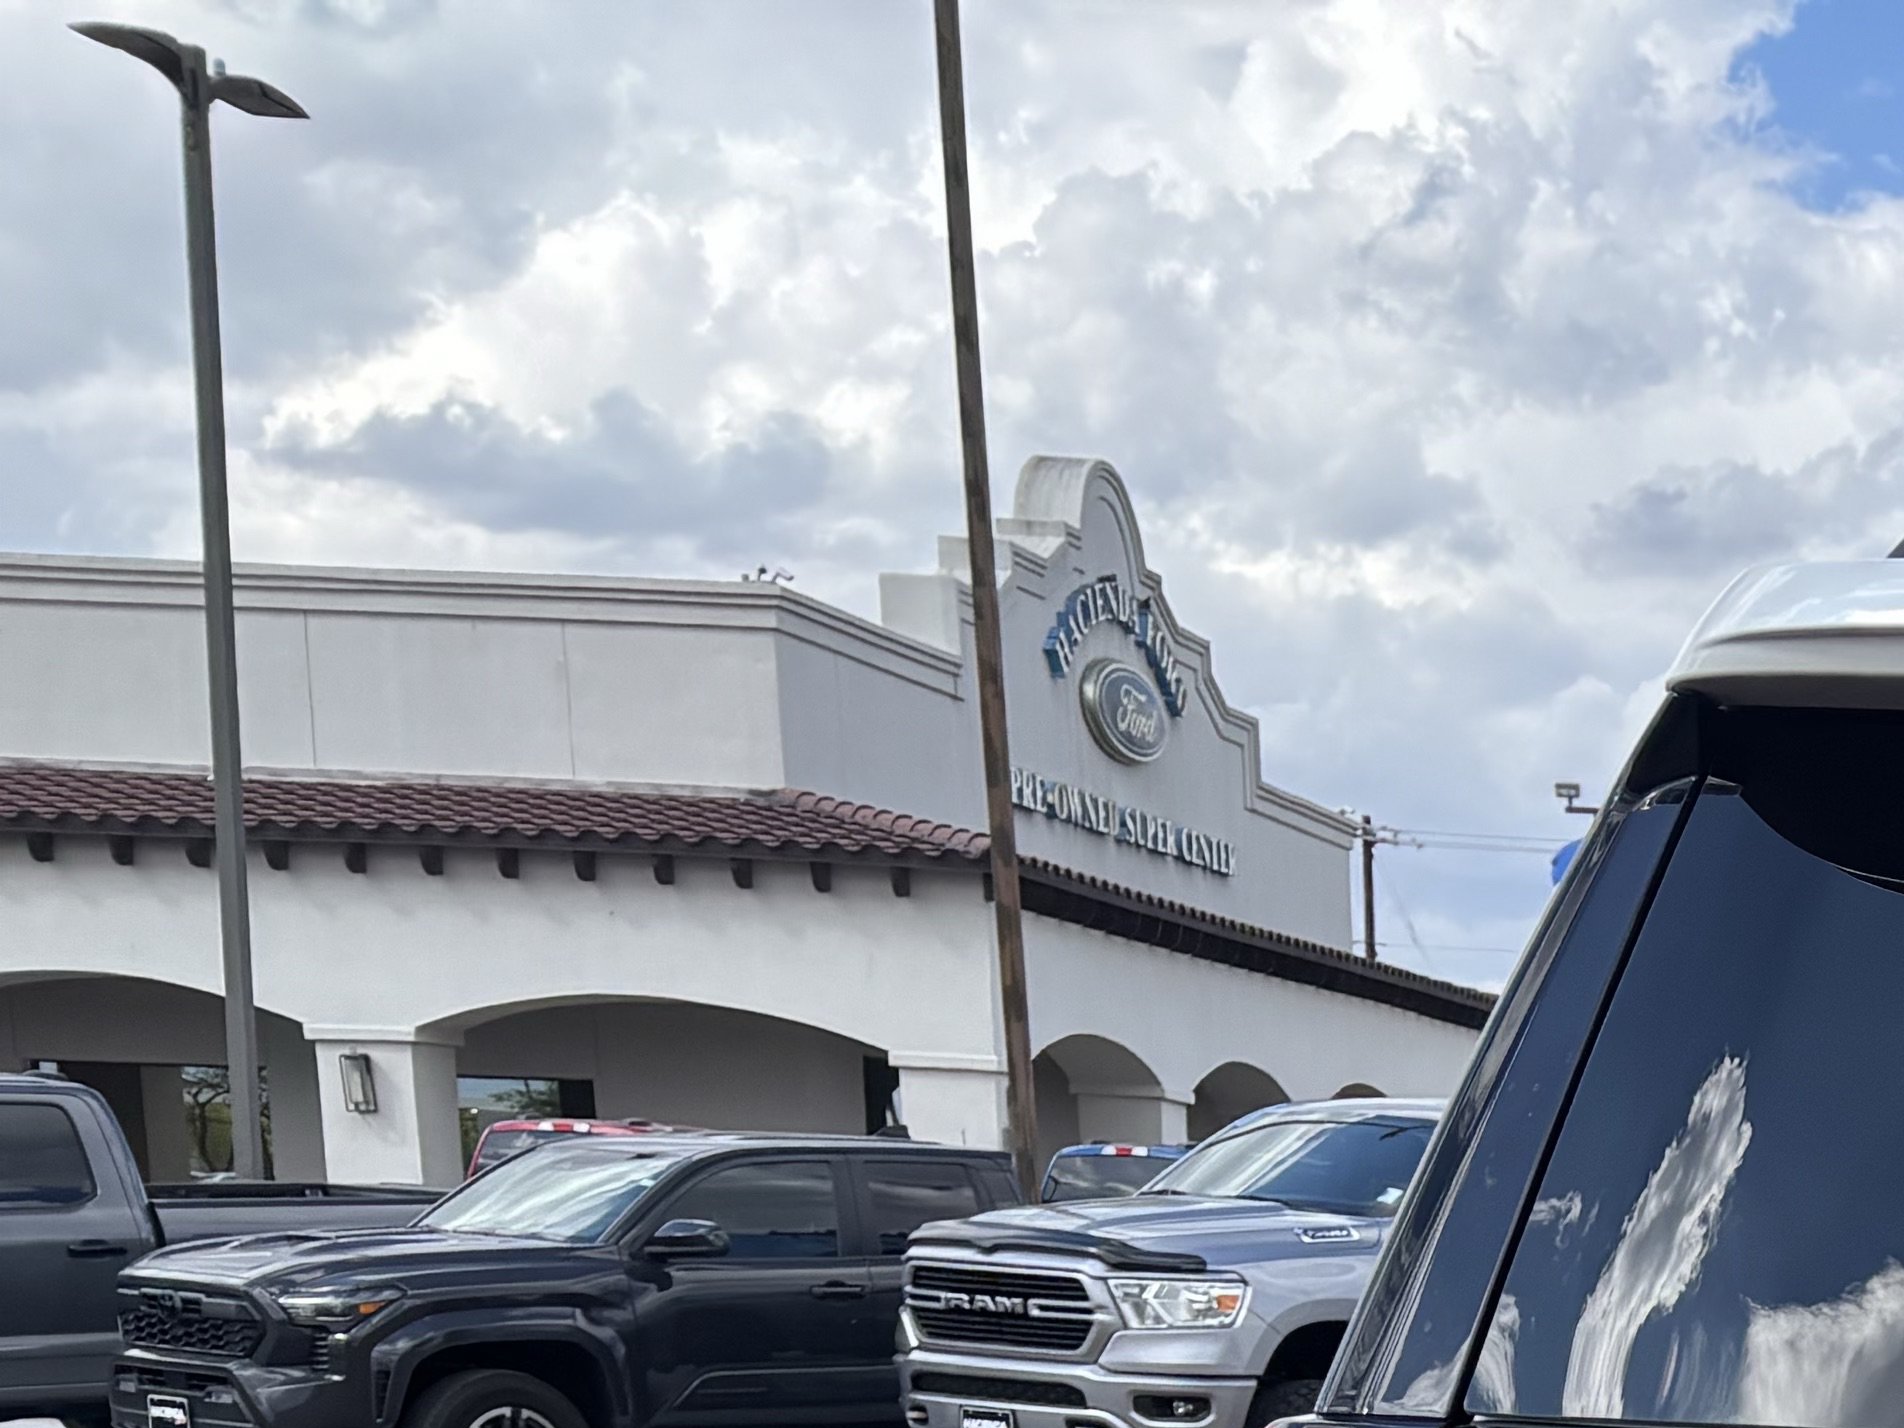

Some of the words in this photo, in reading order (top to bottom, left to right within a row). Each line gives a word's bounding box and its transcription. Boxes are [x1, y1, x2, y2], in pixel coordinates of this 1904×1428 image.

[1054, 581, 1141, 673] HACIENDA
[1116, 683, 1158, 743] Ford
[1010, 766, 1120, 837] PRE-OWNED
[1124, 806, 1178, 857] SUPER
[1181, 827, 1237, 876] CENTER
[945, 1291, 1024, 1315] RAM
